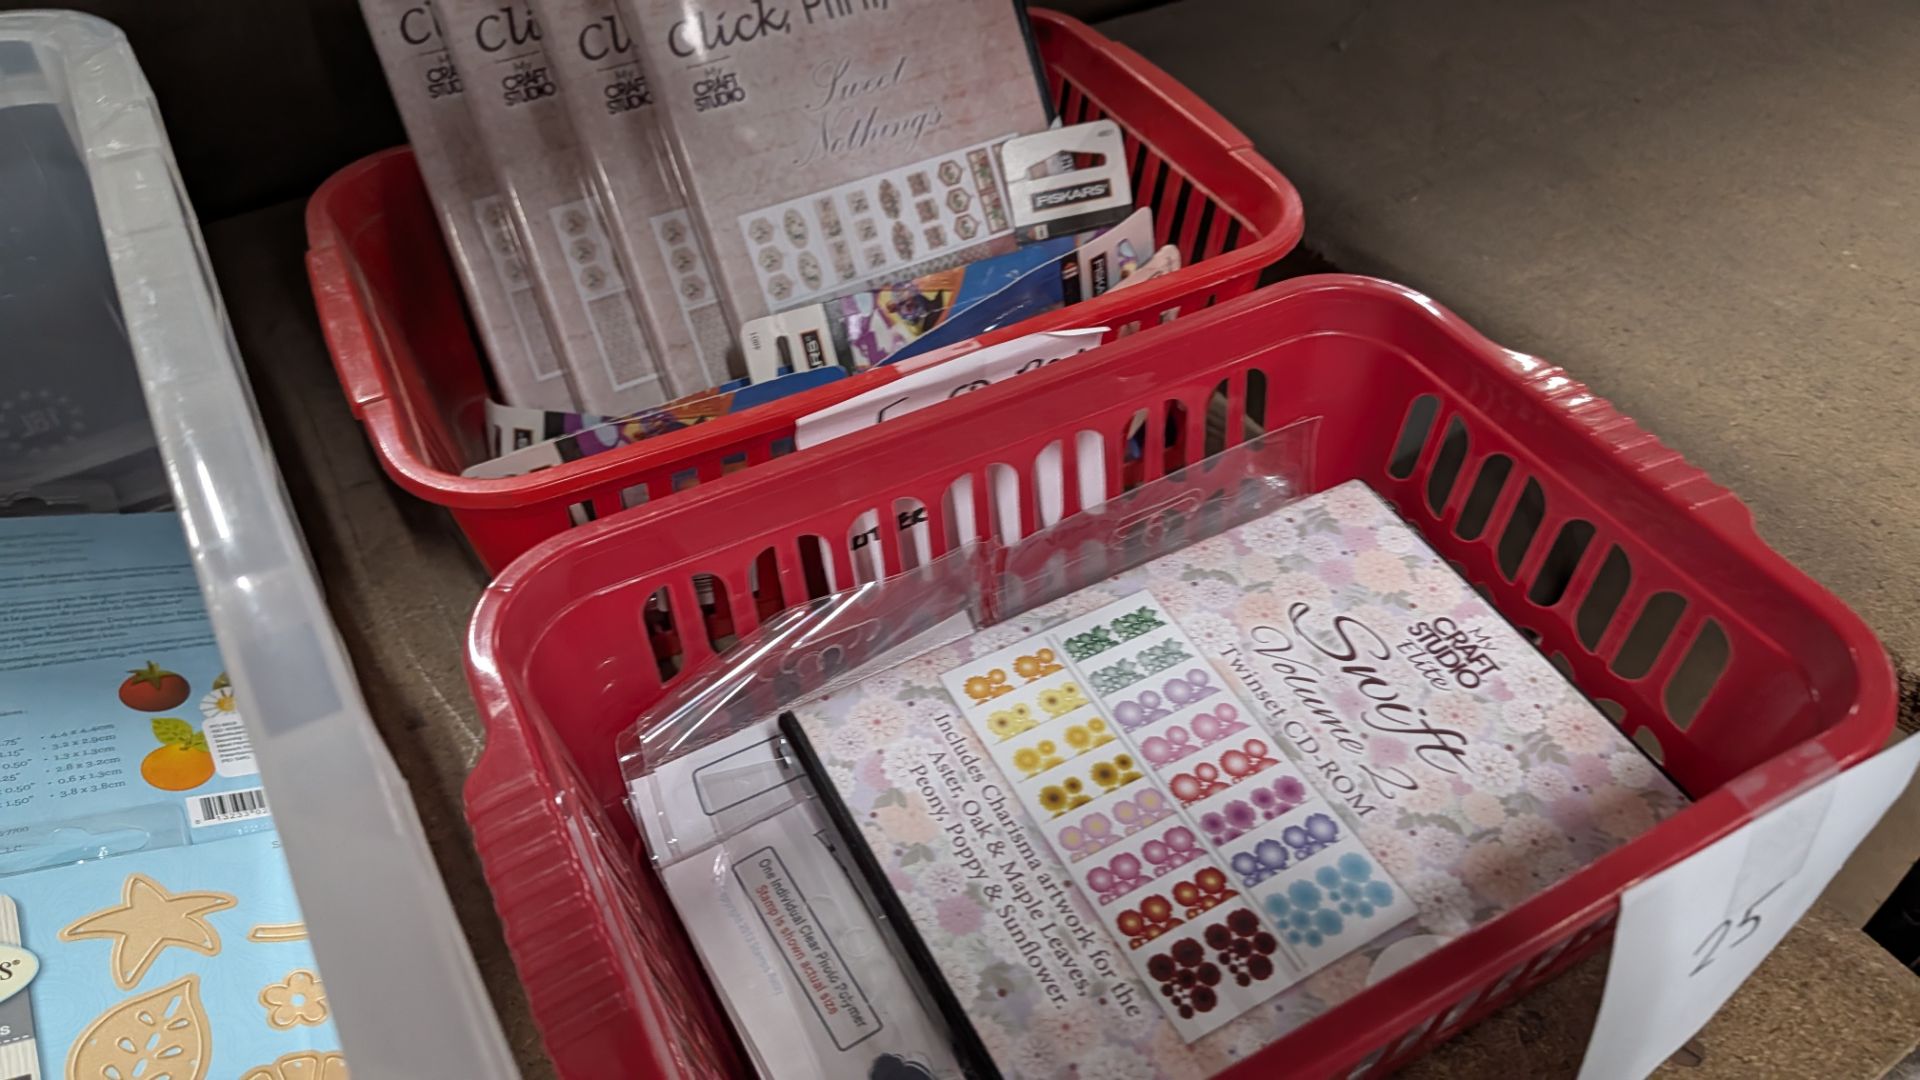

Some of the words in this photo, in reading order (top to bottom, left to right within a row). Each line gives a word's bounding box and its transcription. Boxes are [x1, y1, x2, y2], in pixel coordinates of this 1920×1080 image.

[476, 7, 542, 52] Cli
[668, 0, 791, 57] Click,
[693, 73, 737, 96] CRAFT
[694, 88, 746, 112] STUDIO
[1036, 184, 1107, 208] FISKARS
[1396, 639, 1452, 691] Elite
[1408, 622, 1481, 689] STUDIO
[1432, 617, 1502, 675] CRAFT
[1467, 627, 1498, 650] My
[1250, 625, 1365, 755] Volume
[1358, 764, 1419, 800] 2
[1288, 602, 1473, 774] Swift
[1220, 643, 1286, 718] Twinset
[1284, 720, 1376, 816] CD-ROM
[60, 788, 78, 798] 3.8
[910, 764, 950, 822] Peony,
[948, 822, 991, 881] Poppy
[984, 885, 1003, 903] &
[996, 905, 1069, 1011] Sunflower.
[928, 751, 965, 797] Aster,
[962, 800, 995, 839] Oak
[987, 840, 1007, 858] &
[1000, 859, 1045, 921] Maple
[1040, 922, 1091, 997] Leaves,
[934, 713, 985, 783] Includes
[981, 784, 1042, 871] Charisma
[1038, 873, 1095, 948] artwork
[1091, 950, 1117, 979] for
[1111, 981, 1141, 1018] the
[756, 885, 779, 916] Stamp
[781, 927, 806, 960] shown
[801, 960, 828, 992] actual
[820, 993, 839, 1015] size
[759, 859, 775, 879] One
[770, 879, 808, 926] Individual
[800, 925, 821, 951] Clear
[816, 951, 840, 983] Photo
[834, 982, 868, 1027] Polymer
